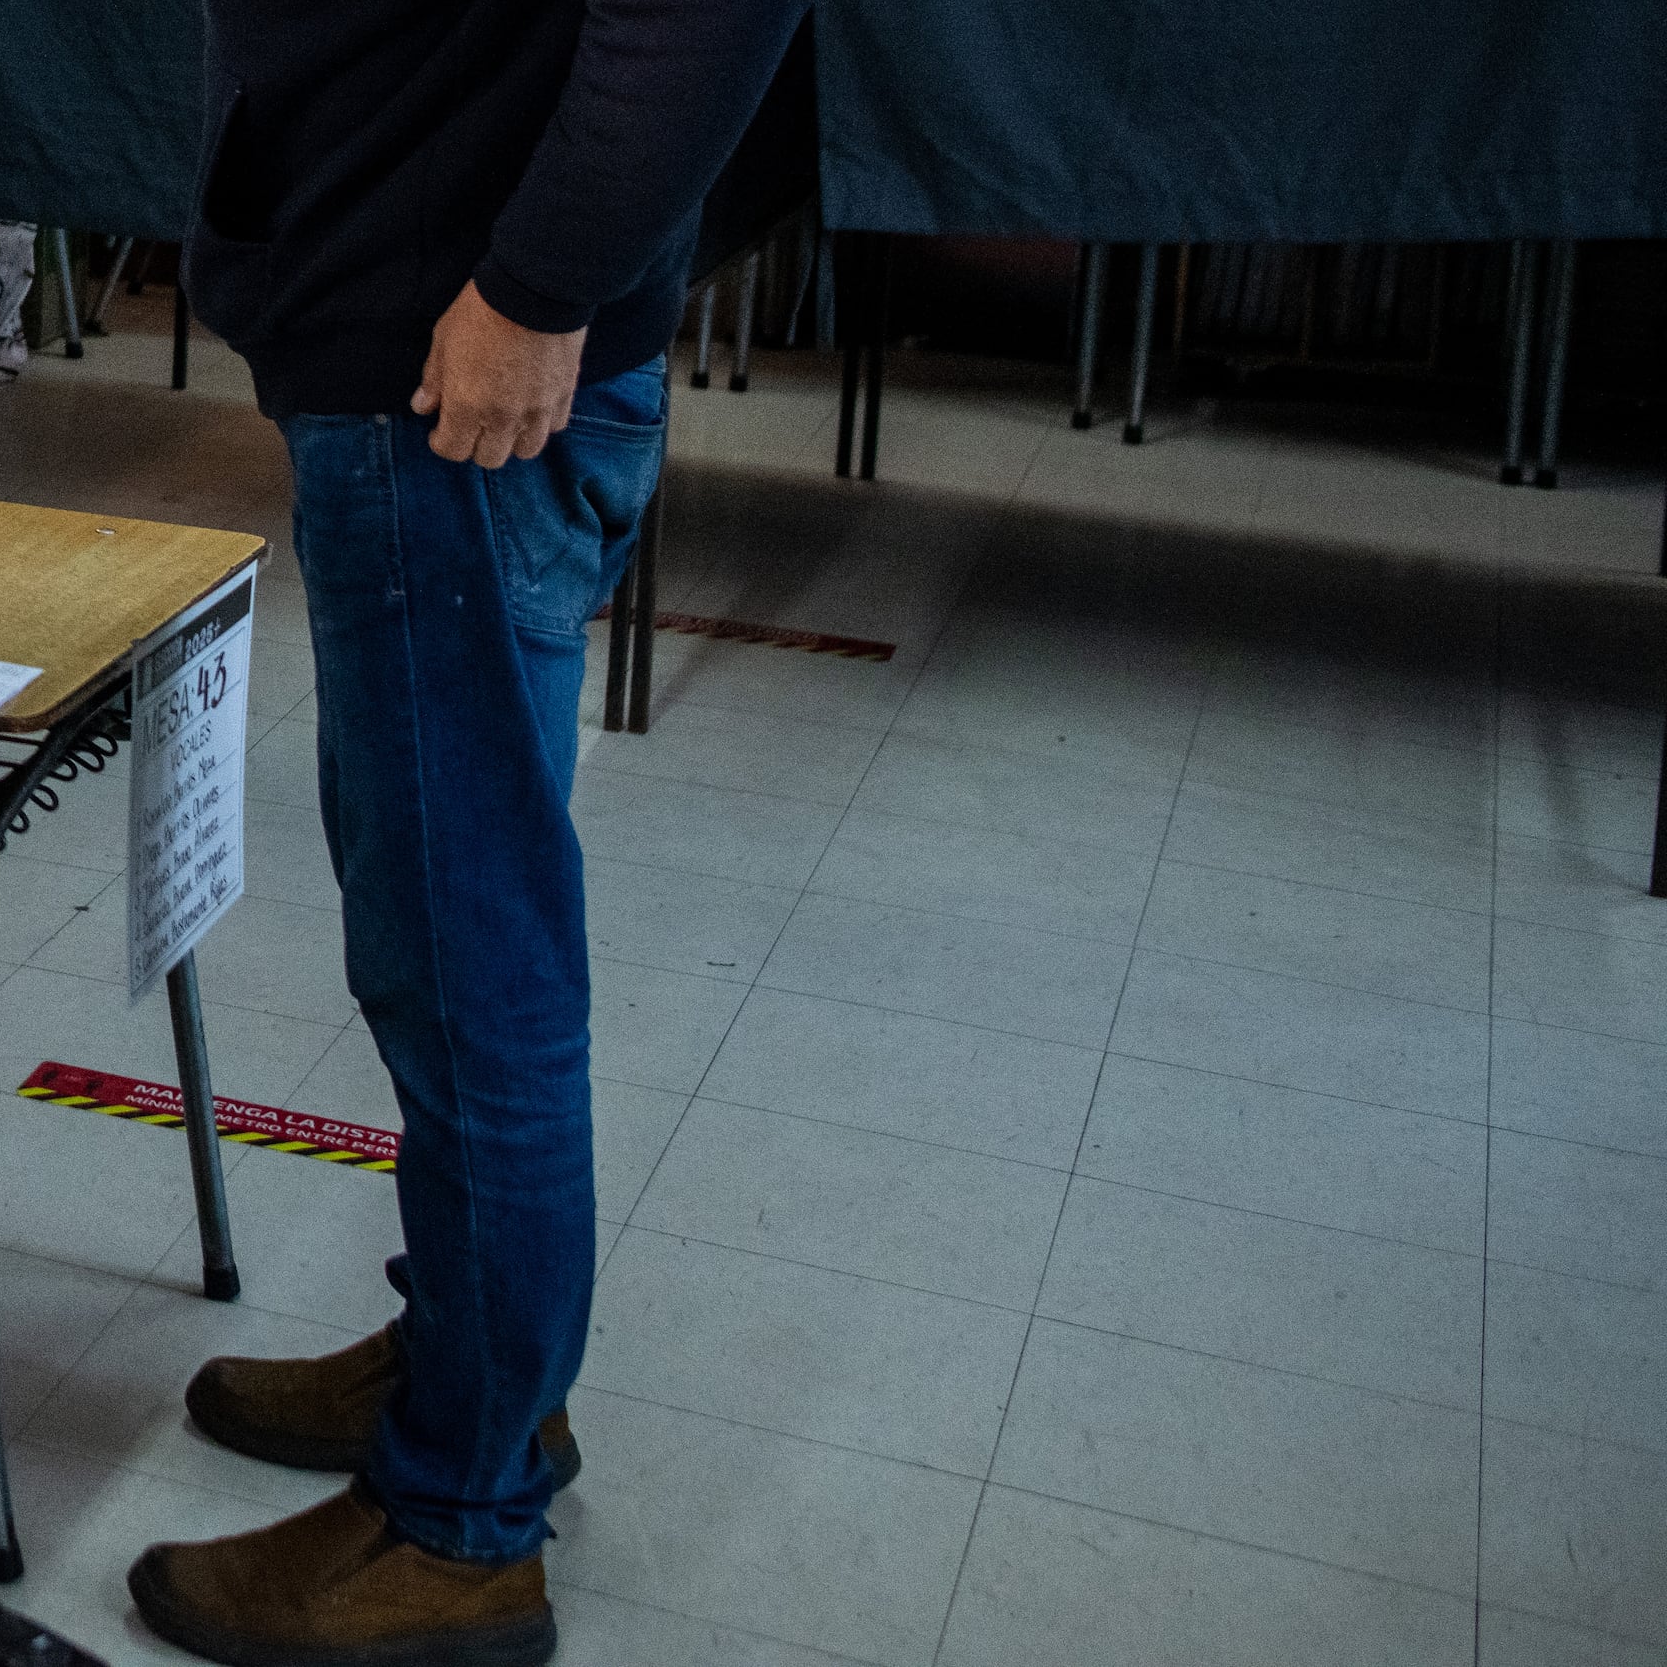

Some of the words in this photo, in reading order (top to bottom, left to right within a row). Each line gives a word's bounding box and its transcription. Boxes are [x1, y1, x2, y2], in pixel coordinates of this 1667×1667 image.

[197, 651, 227, 711] 43
[125, 1094, 186, 1113] MÍNIM
[214, 1113, 283, 1133] METRO
[285, 1127, 349, 1147] ENTRE
[351, 1140, 399, 1158] PERS
[134, 1084, 278, 1122] MAENGA
[285, 1114, 317, 1130] LA
[321, 1122, 397, 1146] DISTA
